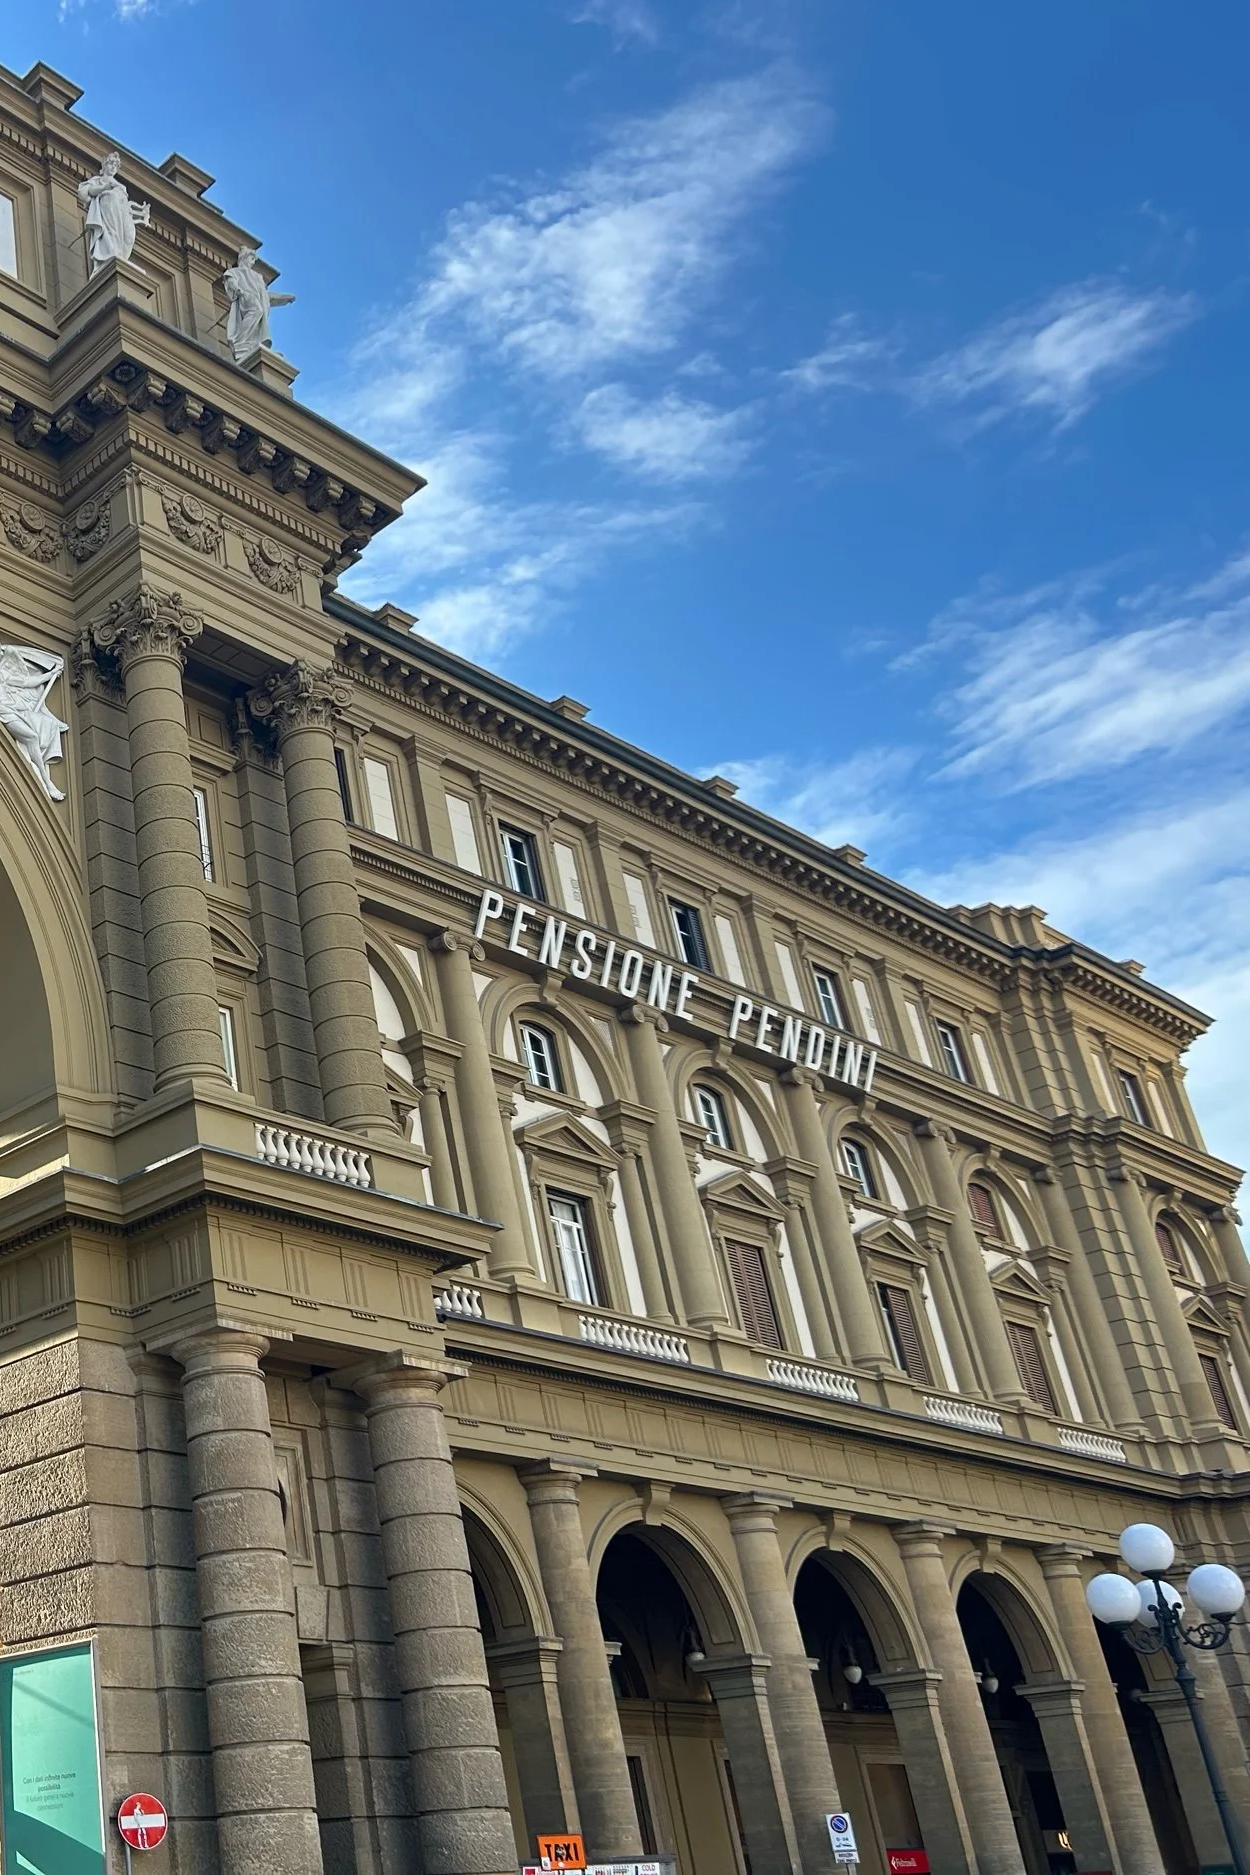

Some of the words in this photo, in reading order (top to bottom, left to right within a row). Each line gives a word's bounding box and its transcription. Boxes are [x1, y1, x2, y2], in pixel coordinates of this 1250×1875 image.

[474, 888, 699, 1021] PENSIONE
[729, 994, 878, 1092] PENDINI
[544, 1842, 580, 1862] TAXI
